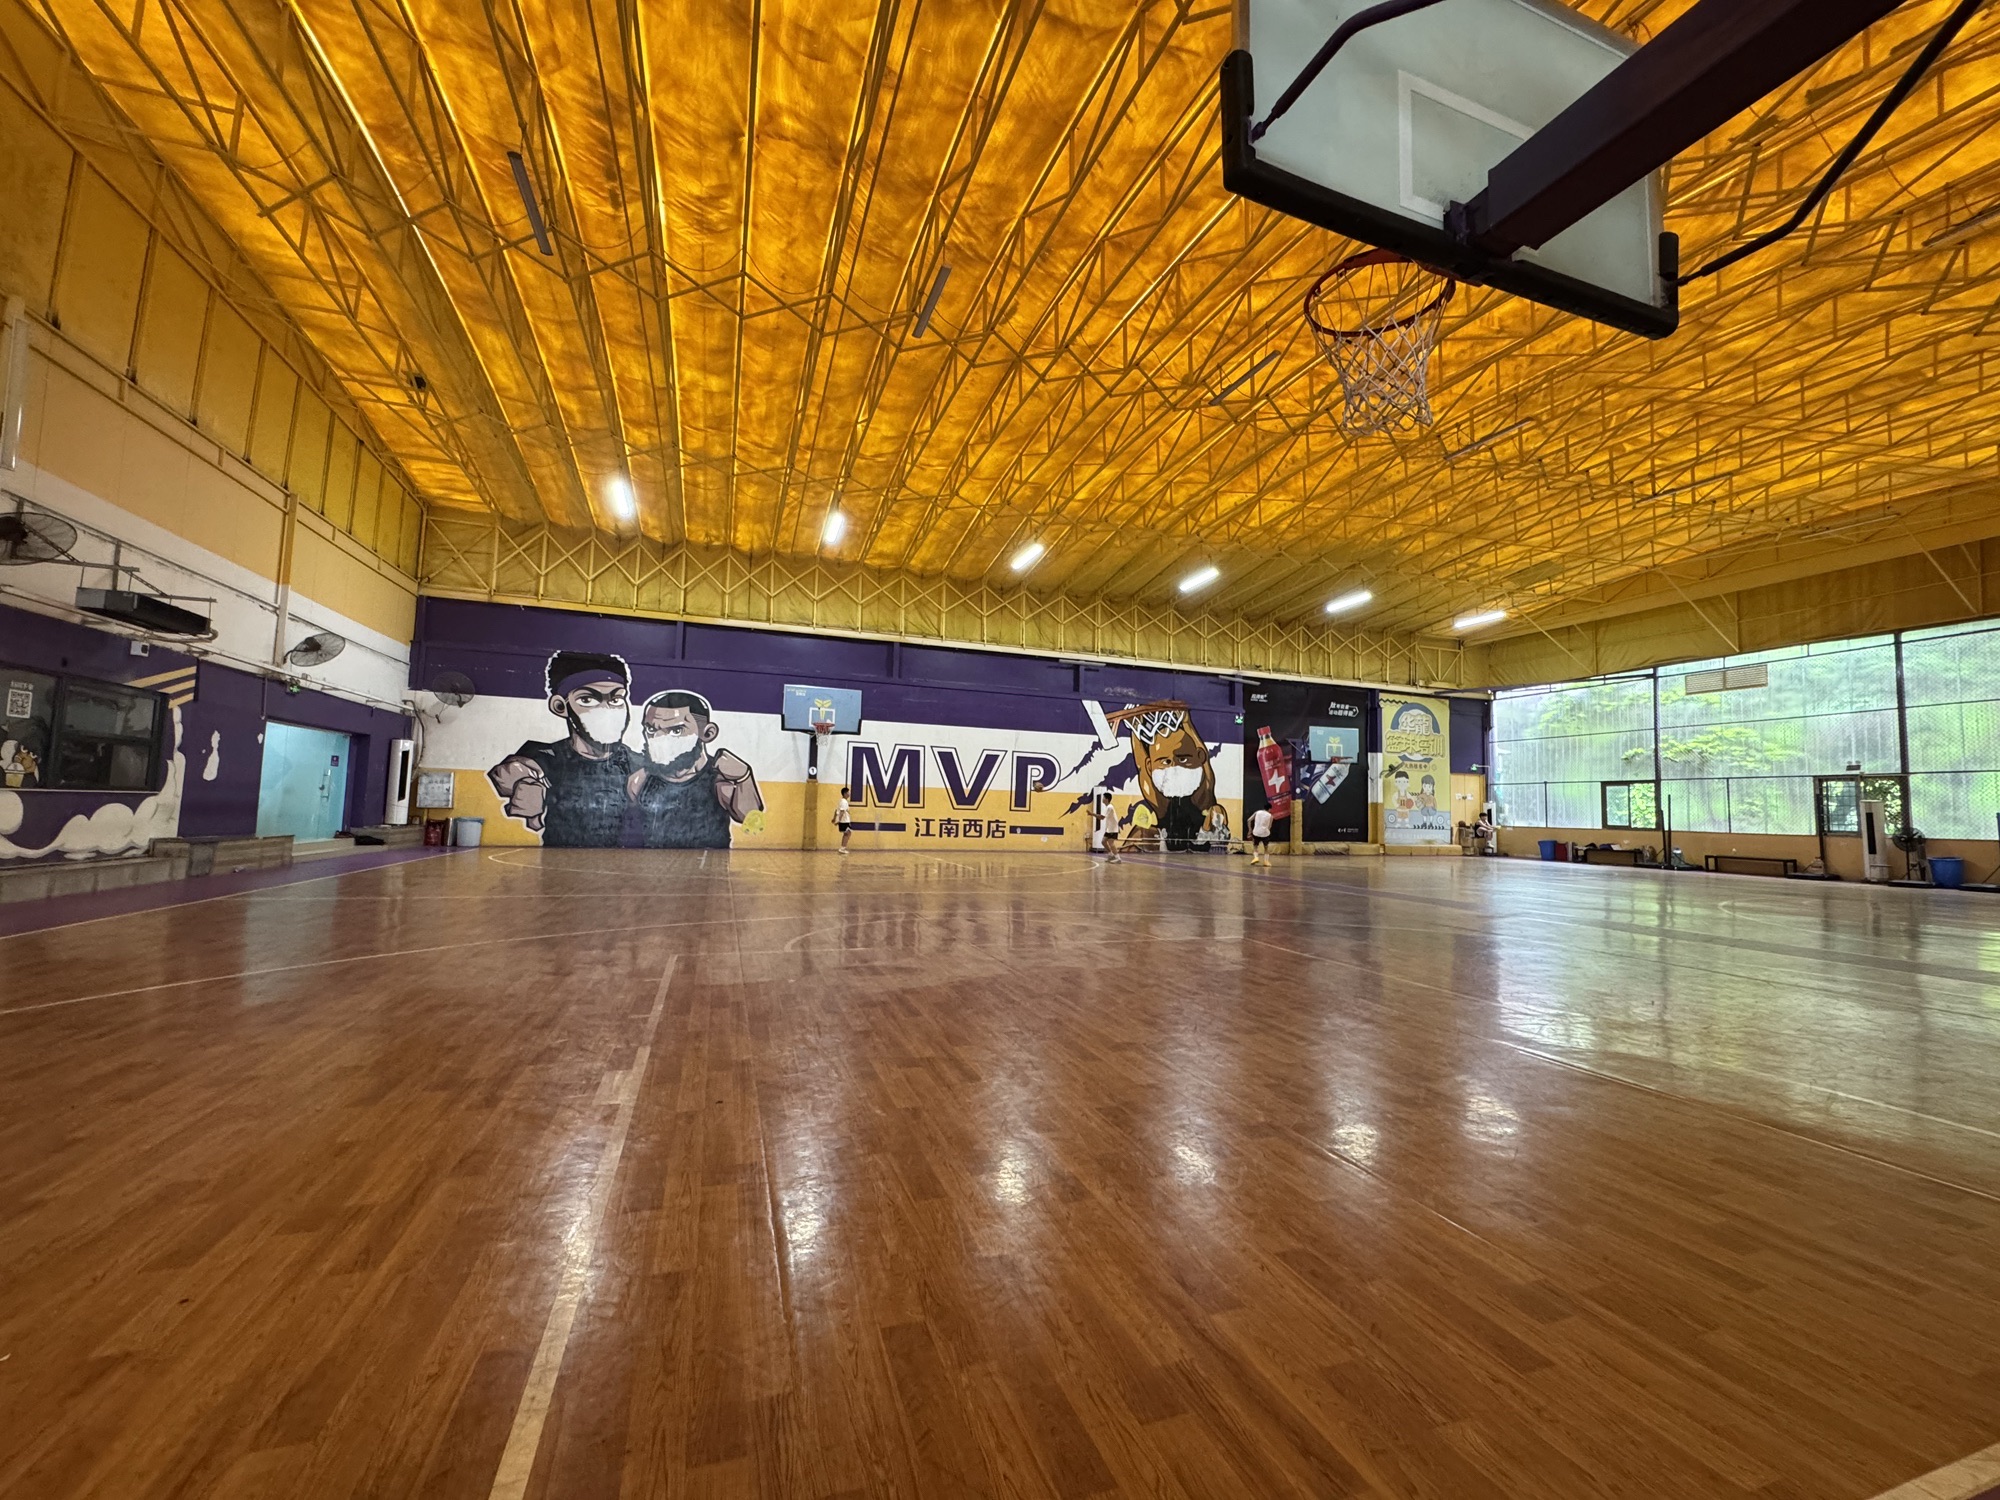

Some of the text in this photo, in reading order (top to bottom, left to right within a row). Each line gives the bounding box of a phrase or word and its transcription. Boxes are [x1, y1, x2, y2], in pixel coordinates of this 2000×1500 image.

[1386, 734, 1446, 758] 篮球培训
[846, 741, 1061, 812] MVP
[914, 817, 1007, 840] 江南西店
